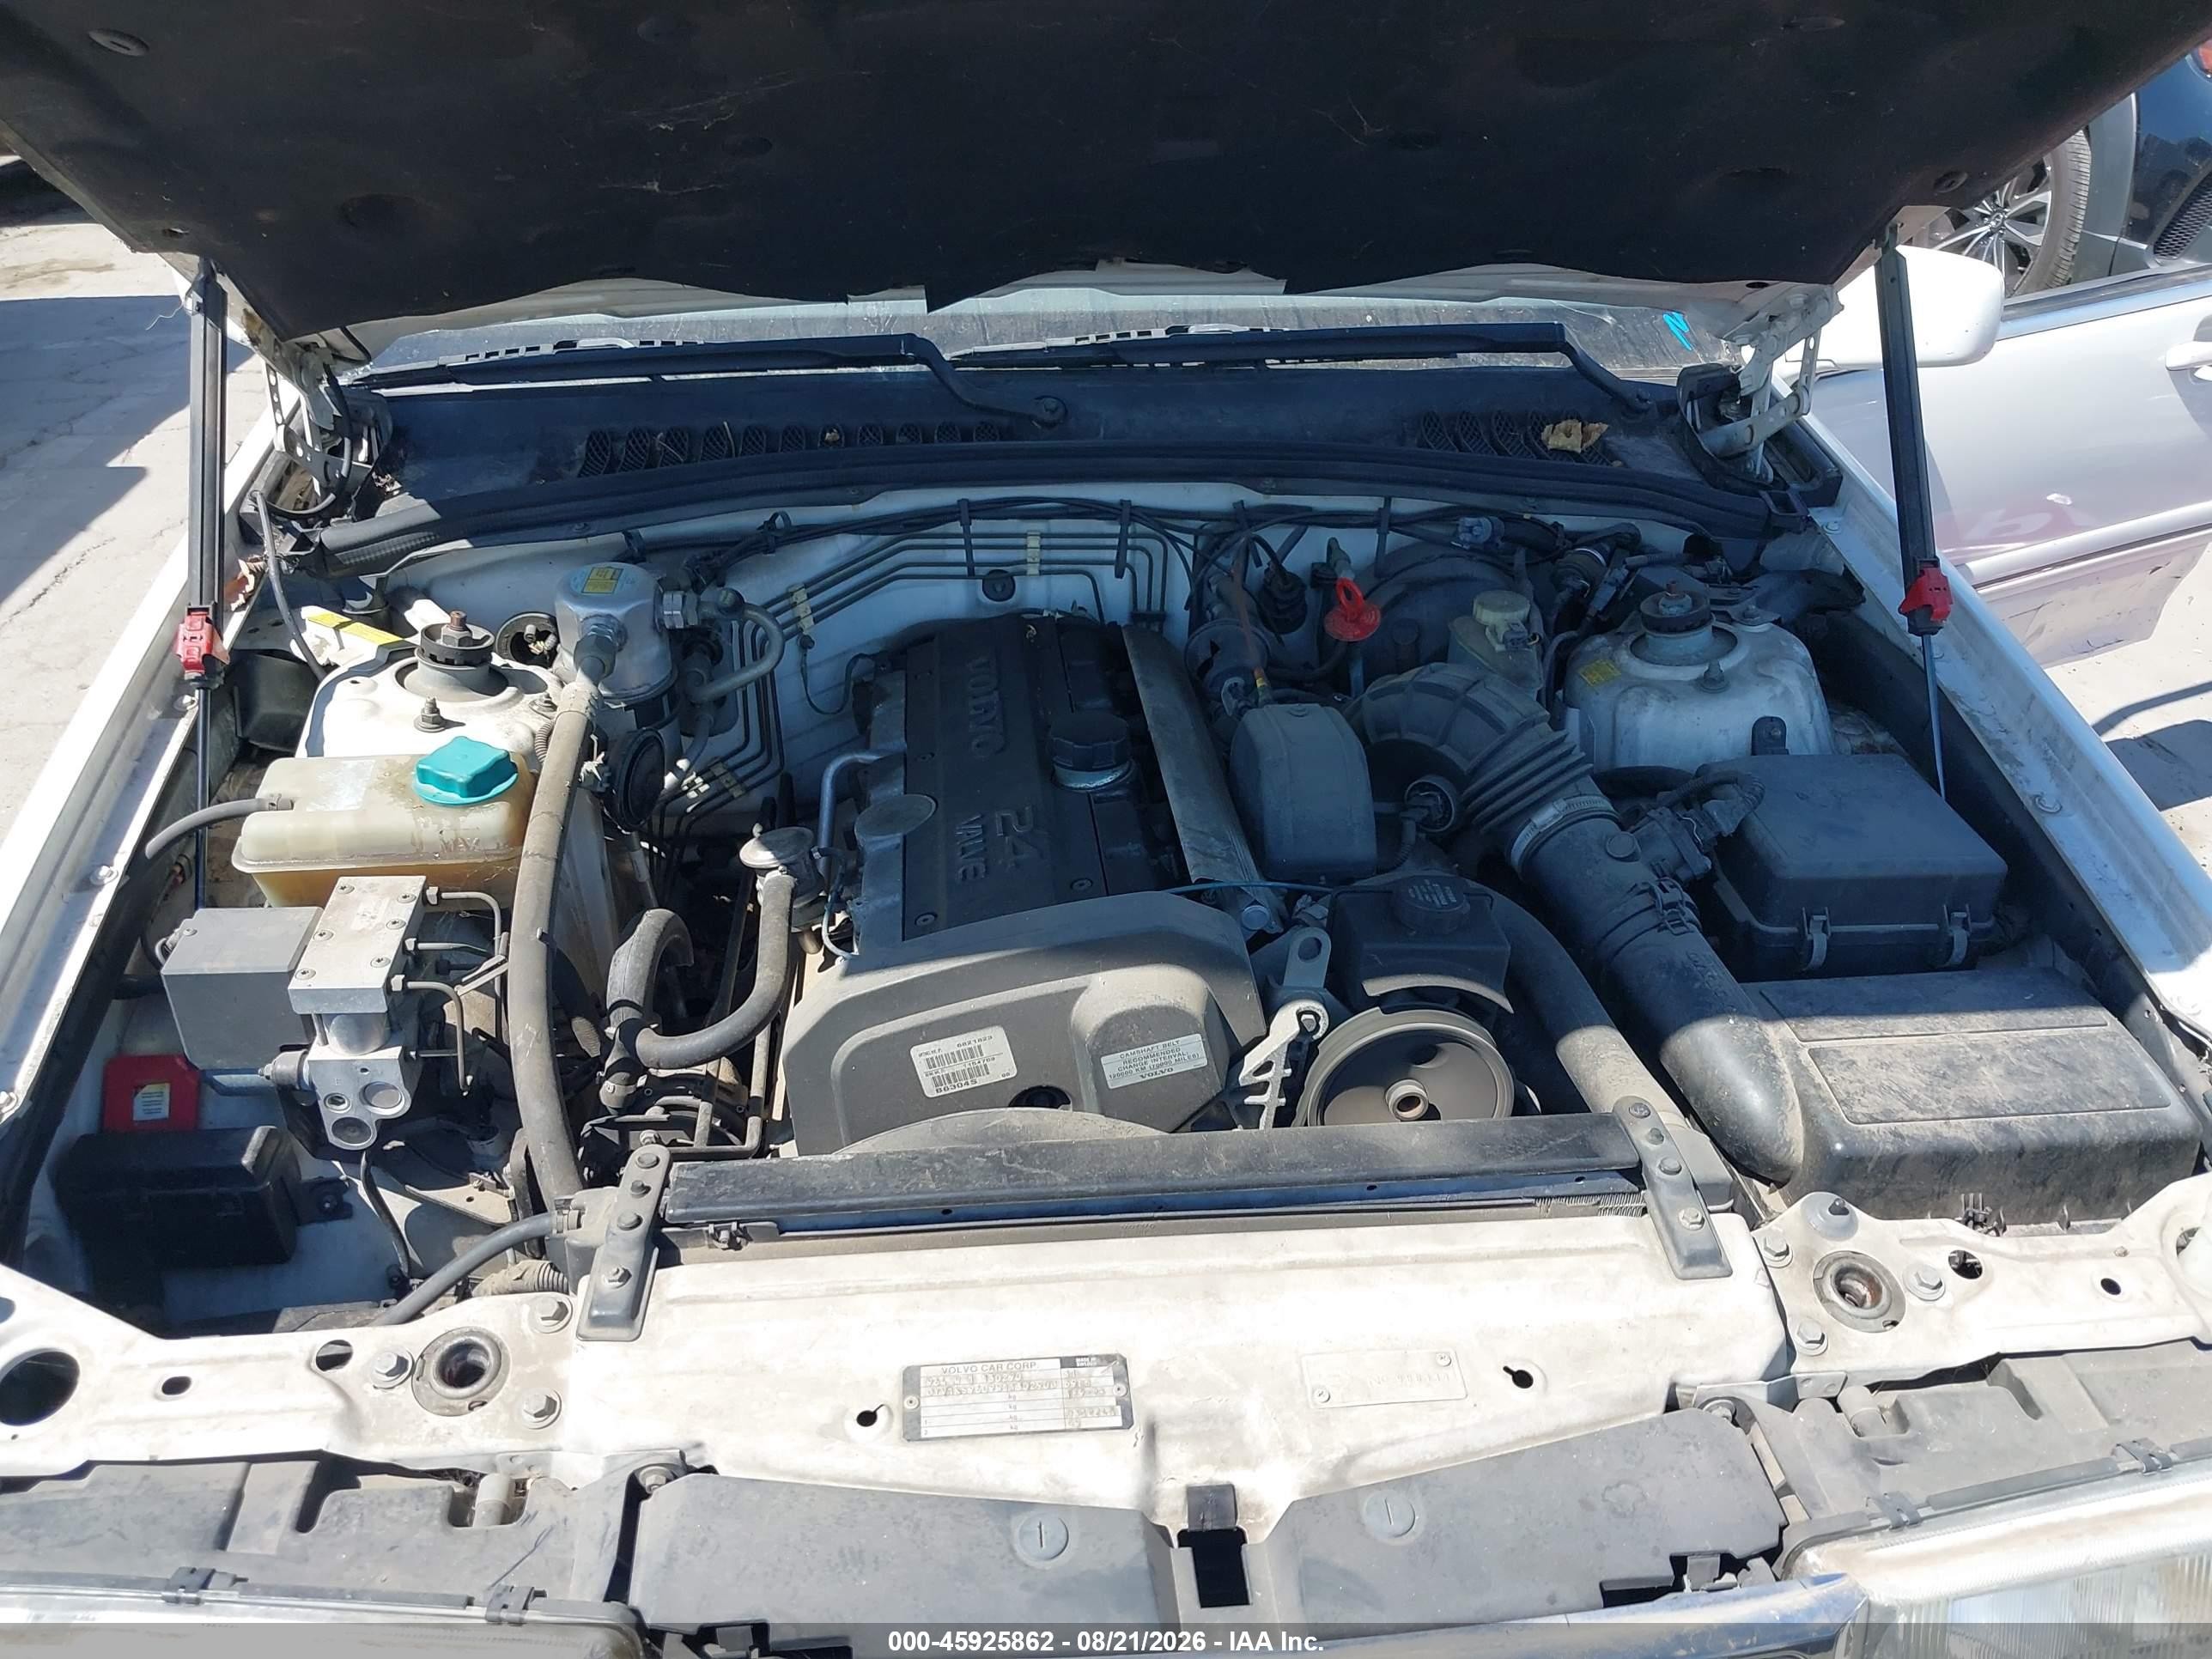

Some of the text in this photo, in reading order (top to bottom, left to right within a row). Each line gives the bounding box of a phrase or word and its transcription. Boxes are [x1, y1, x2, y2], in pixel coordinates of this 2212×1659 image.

[994, 806, 1044, 869] 24
[955, 813, 988, 883] VALVE
[1120, 1039, 1181, 1059] CAMSHAFT BELT
[1122, 1047, 1182, 1065] RECOMMENDED
[1117, 1060, 1146, 1072] CHANGE
[1139, 1067, 1173, 1079] VOLVO
[935, 1079, 978, 1094] B6304S
[940, 1364, 980, 1375] VOLVO
[981, 1363, 1006, 1373] CAR
